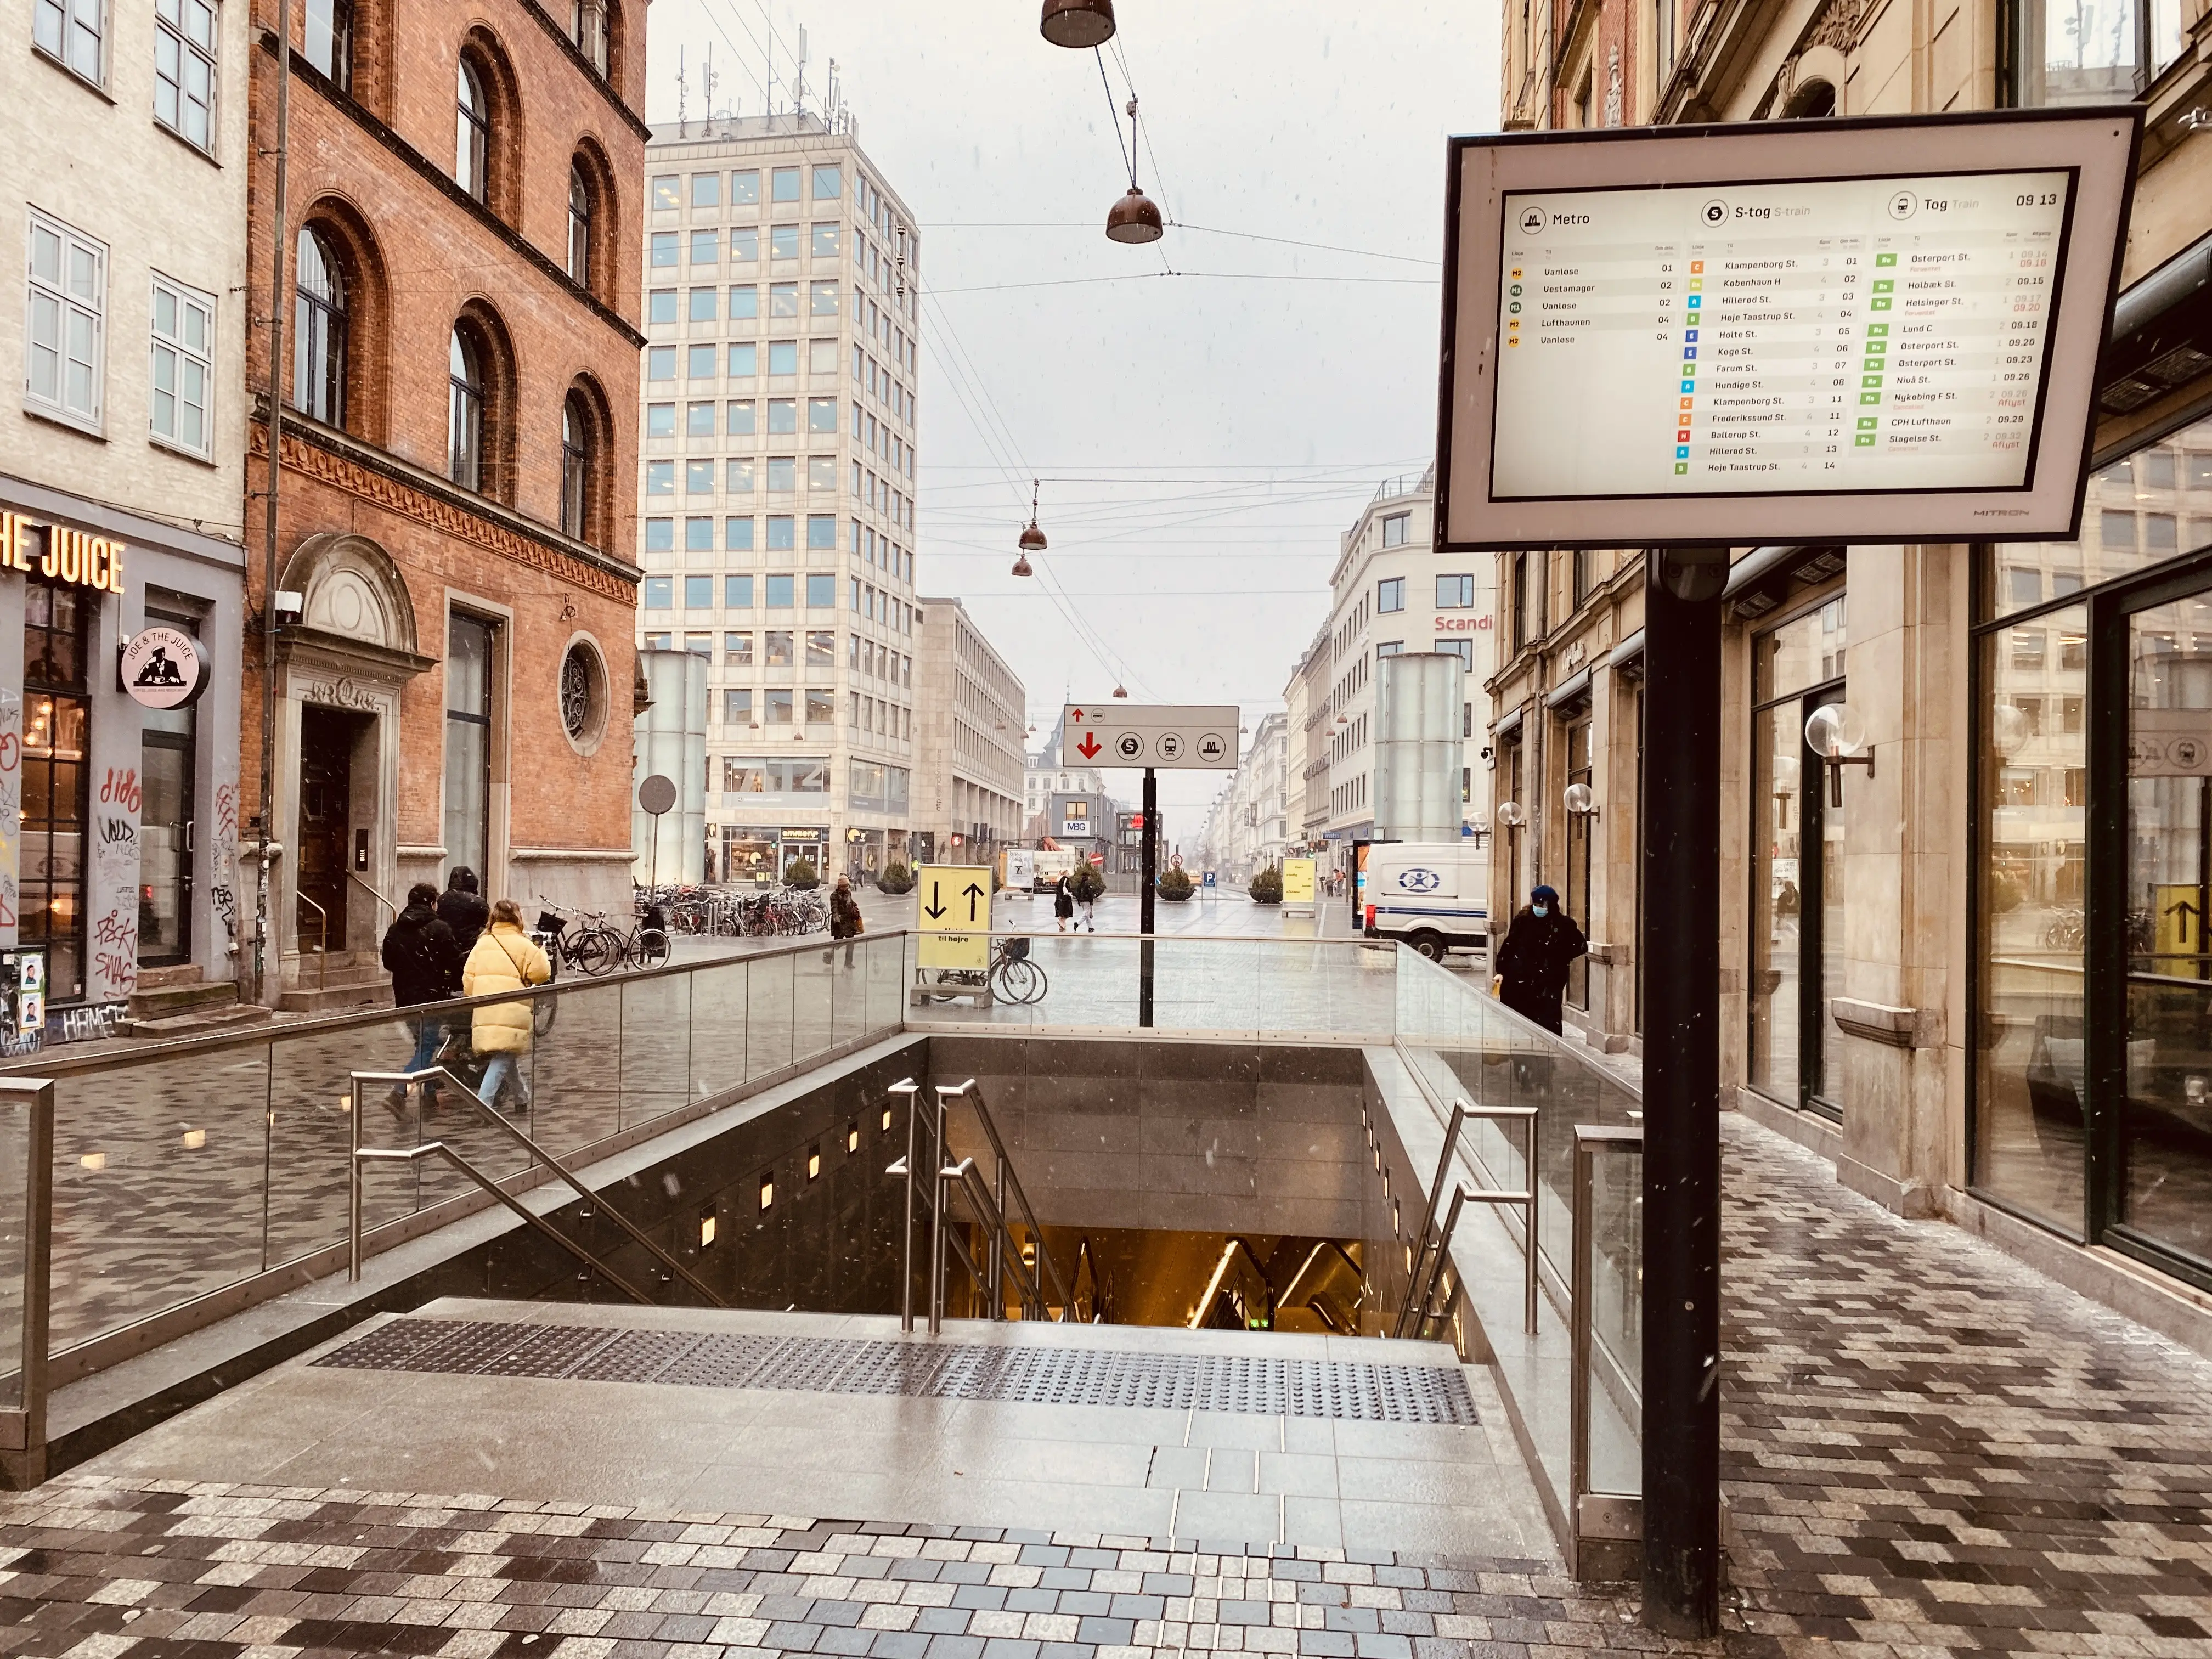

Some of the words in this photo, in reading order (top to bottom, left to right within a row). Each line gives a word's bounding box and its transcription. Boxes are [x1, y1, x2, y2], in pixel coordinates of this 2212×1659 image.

[1925, 199, 1948, 211] Tog
[1953, 199, 1979, 208] Train
[2017, 195, 2034, 206] 09
[2040, 194, 2057, 205] 13
[1736, 207, 1770, 218] S-tog
[1775, 207, 1810, 216] S-train
[1553, 215, 1590, 224] Metro
[1716, 381, 1750, 390] Hundige
[1993, 441, 2019, 449] Aflyst
[42, 524, 125, 594] JUICE
[128, 641, 143, 660] JOE
[142, 636, 149, 645] &
[151, 632, 170, 641] THE
[171, 637, 193, 660] JUICE
[1206, 873, 1213, 882] P
